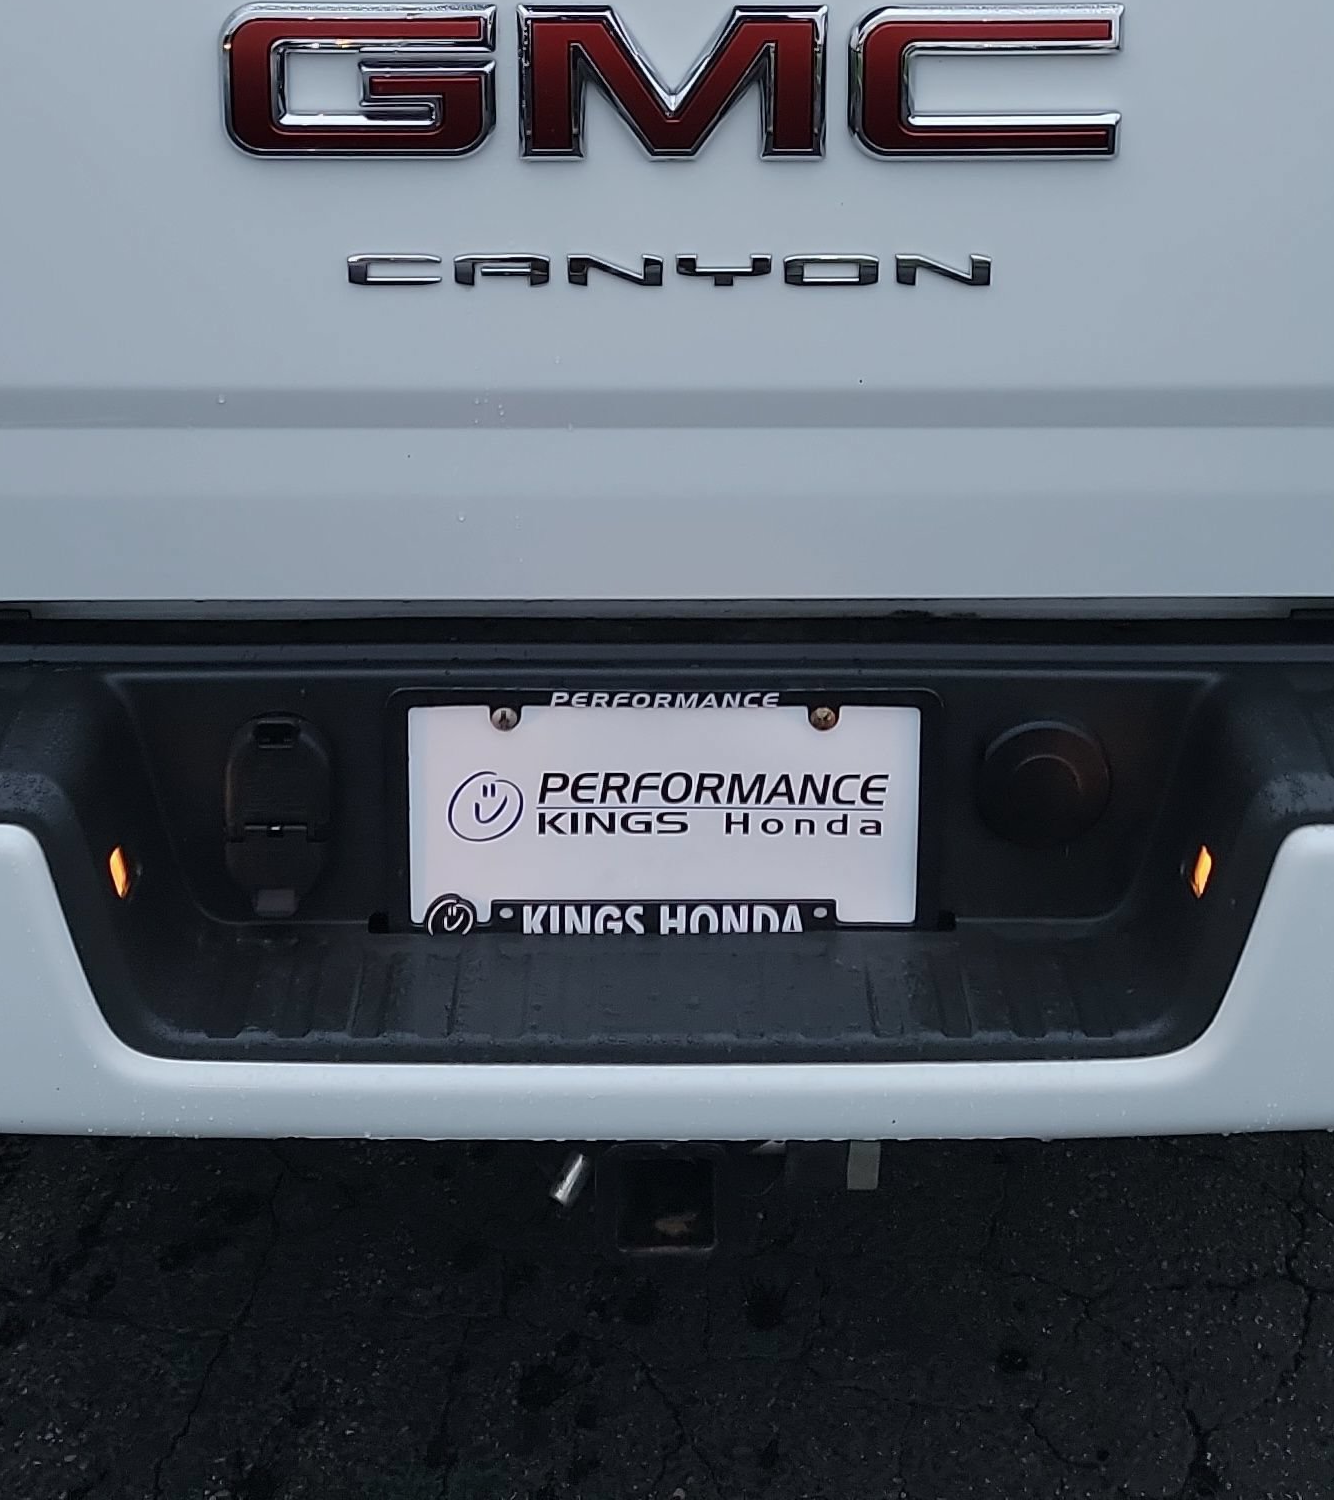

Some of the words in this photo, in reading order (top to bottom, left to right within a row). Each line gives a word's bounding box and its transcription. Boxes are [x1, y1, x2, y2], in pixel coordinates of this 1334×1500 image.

[222, 2, 1125, 161] GMC
[347, 253, 992, 287] CANYON
[550, 691, 779, 709] PERFORMANCE
[537, 772, 889, 805] PERFORMANCE
[538, 812, 689, 835] KINGS
[724, 812, 884, 836] Honda
[522, 904, 644, 935] KINGS
[659, 904, 804, 934] HONDA
